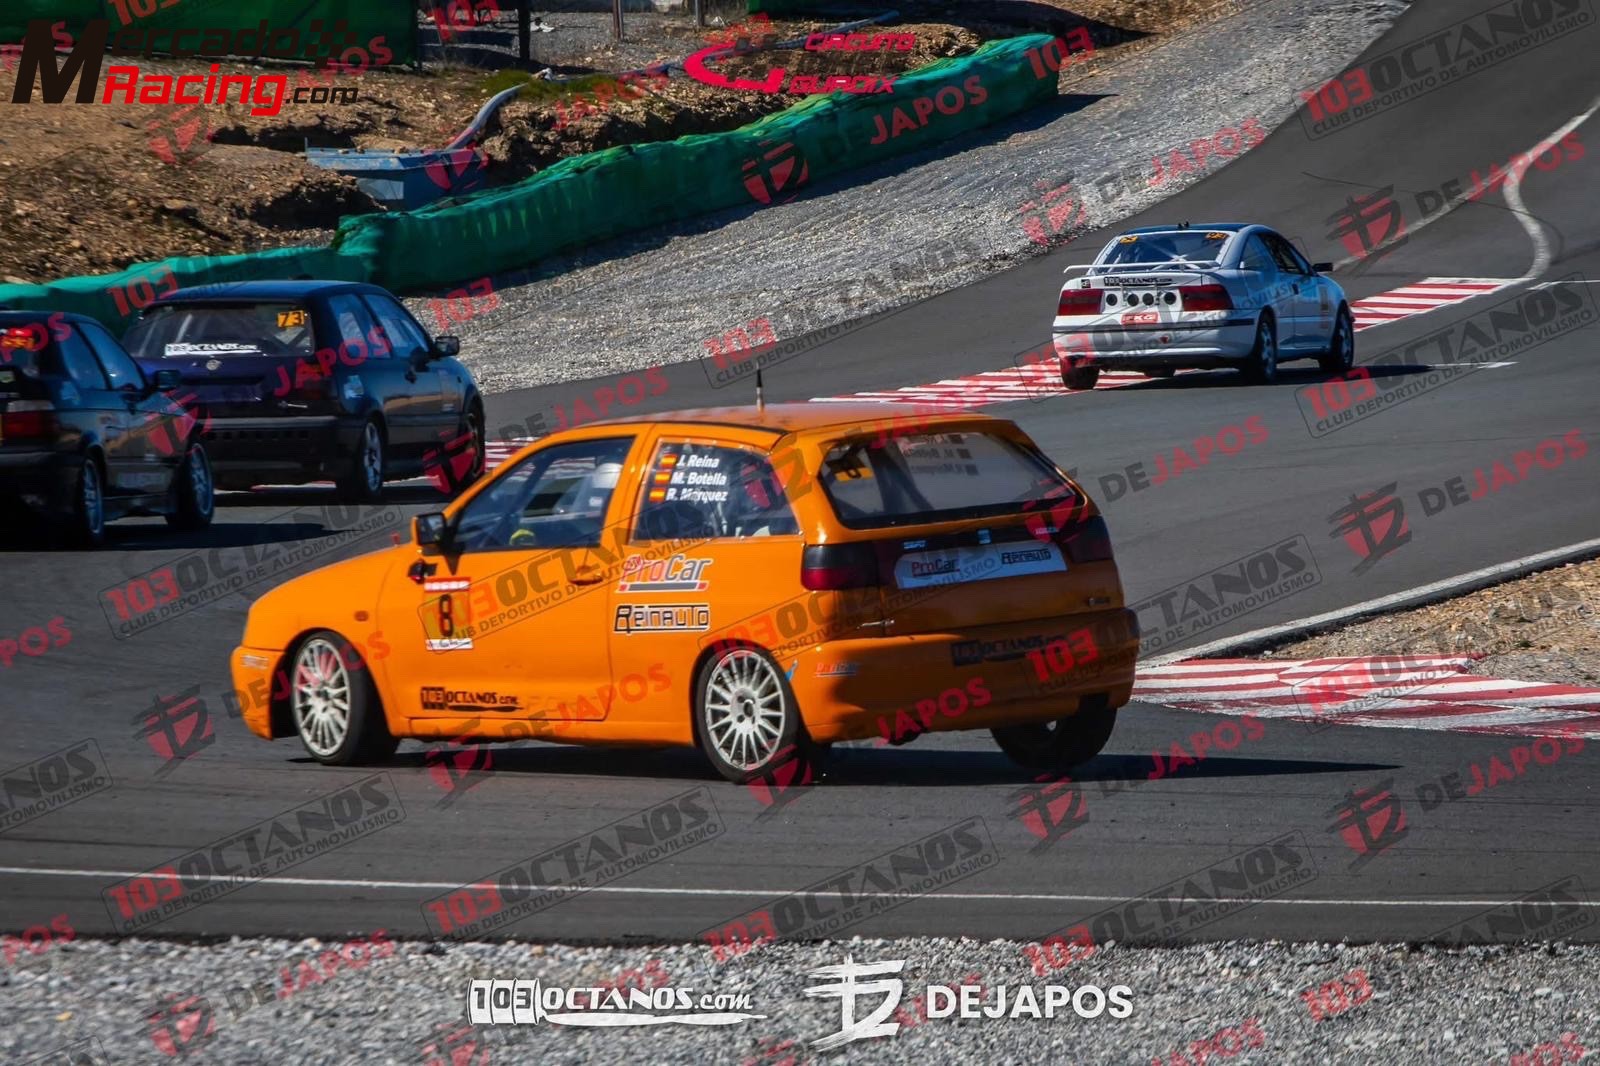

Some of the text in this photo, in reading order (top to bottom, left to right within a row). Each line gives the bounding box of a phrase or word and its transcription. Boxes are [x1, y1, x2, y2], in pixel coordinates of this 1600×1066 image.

[279, 312, 302, 326] 73
[687, 454, 721, 468] Reina
[670, 471, 728, 486] M. Botella
[438, 593, 455, 637] 8
